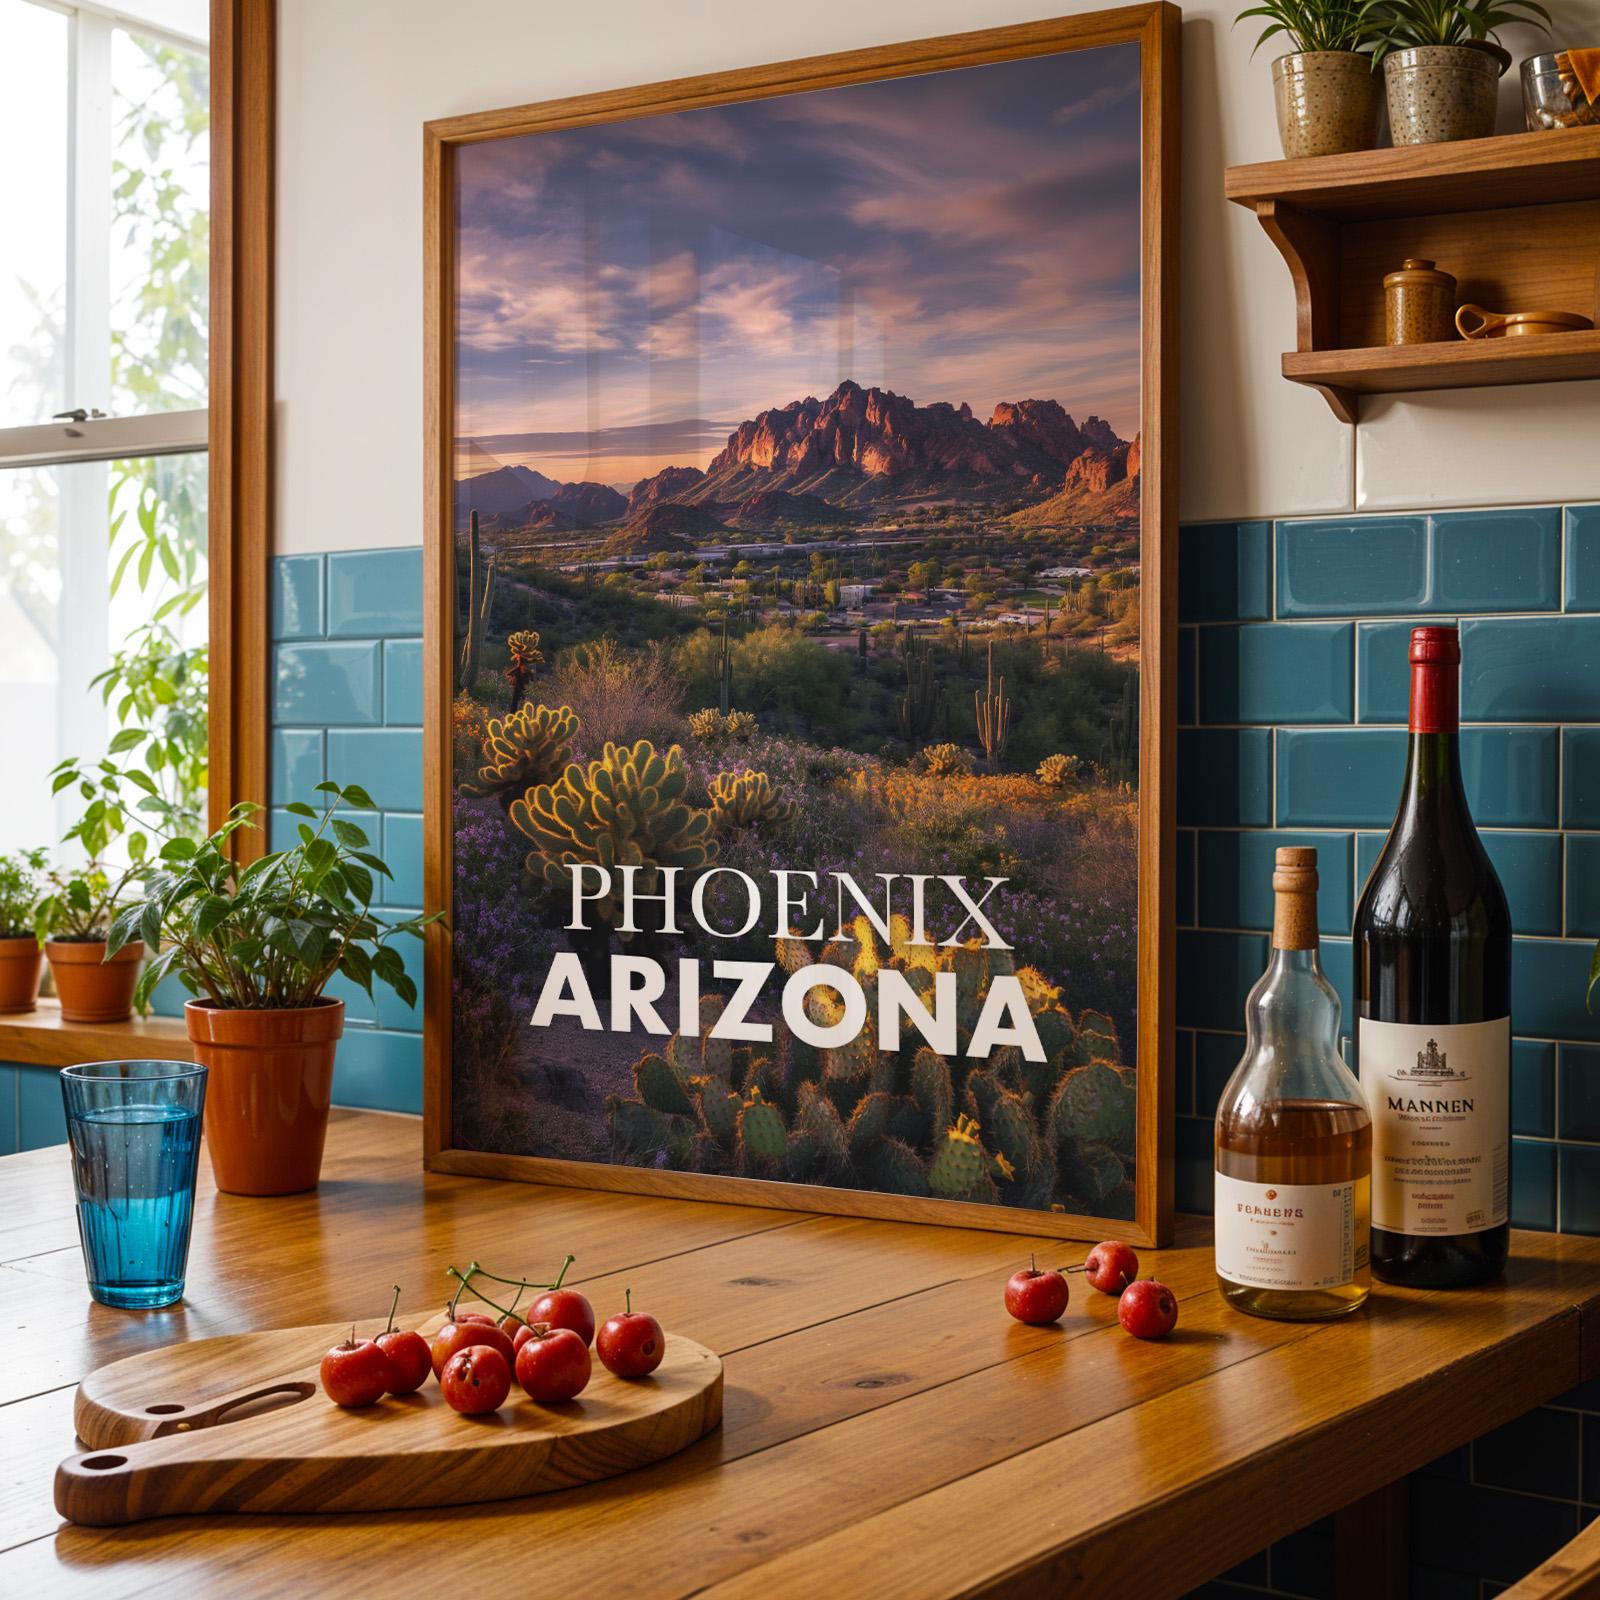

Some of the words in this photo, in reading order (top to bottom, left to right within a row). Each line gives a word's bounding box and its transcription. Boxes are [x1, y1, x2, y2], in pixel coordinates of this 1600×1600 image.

[563, 864, 1015, 950] PHOENIX
[529, 952, 1048, 1063] ARIZONA
[1387, 1097, 1474, 1113] MANNEN
